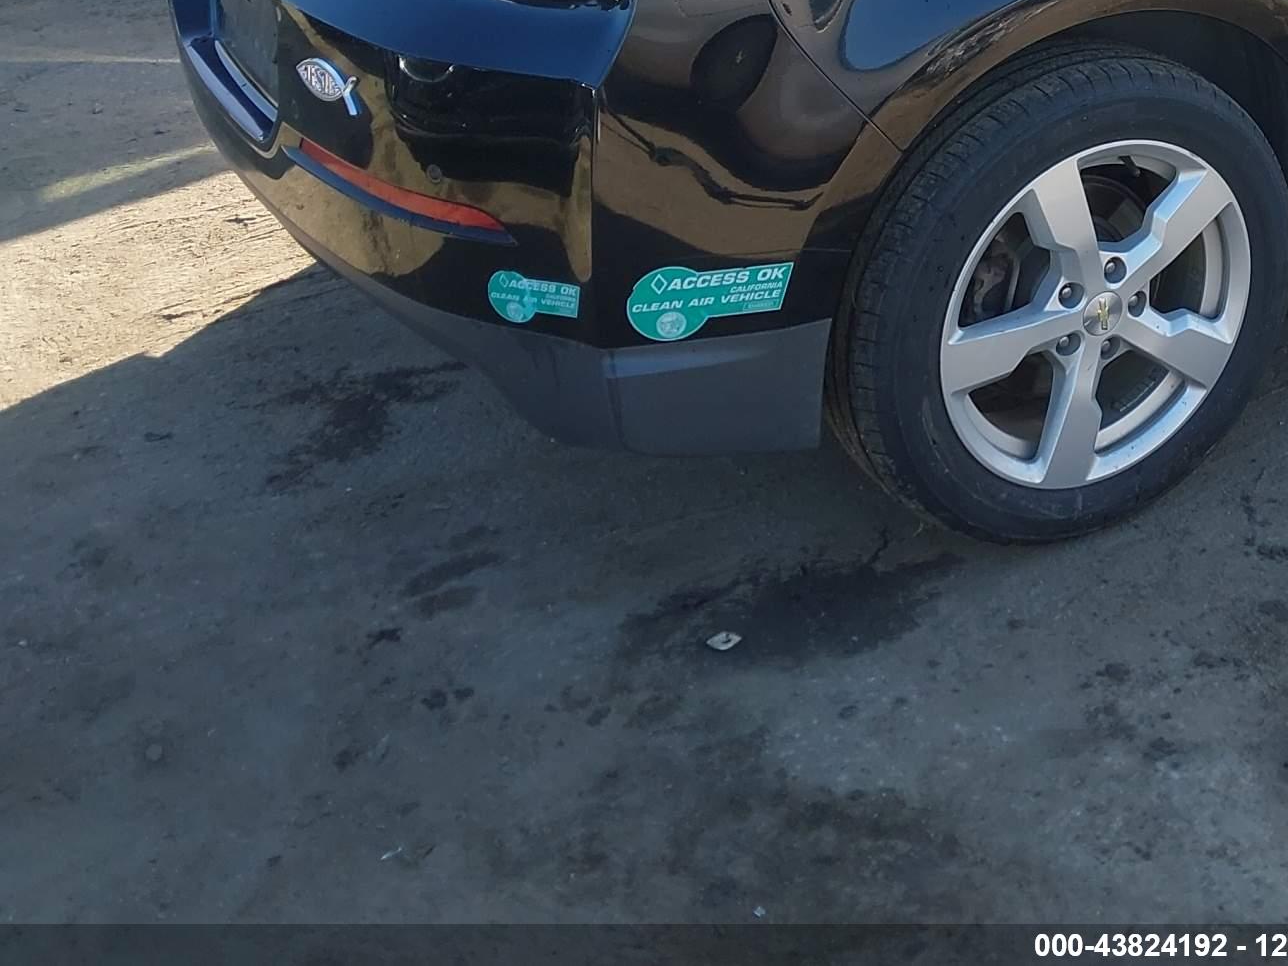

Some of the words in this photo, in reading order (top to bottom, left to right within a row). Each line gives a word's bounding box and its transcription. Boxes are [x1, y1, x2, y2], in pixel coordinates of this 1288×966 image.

[667, 271, 750, 291] ACCESS
[757, 266, 788, 281] OK
[508, 279, 556, 293] ACCESS
[560, 286, 577, 296] OK
[729, 281, 783, 294] CALIFORNIA
[491, 291, 520, 301] CLEAN
[541, 297, 576, 308] VEHICLE
[632, 300, 684, 313] CLEAN
[688, 297, 715, 307] AIR
[721, 289, 781, 304] VEHICLE
